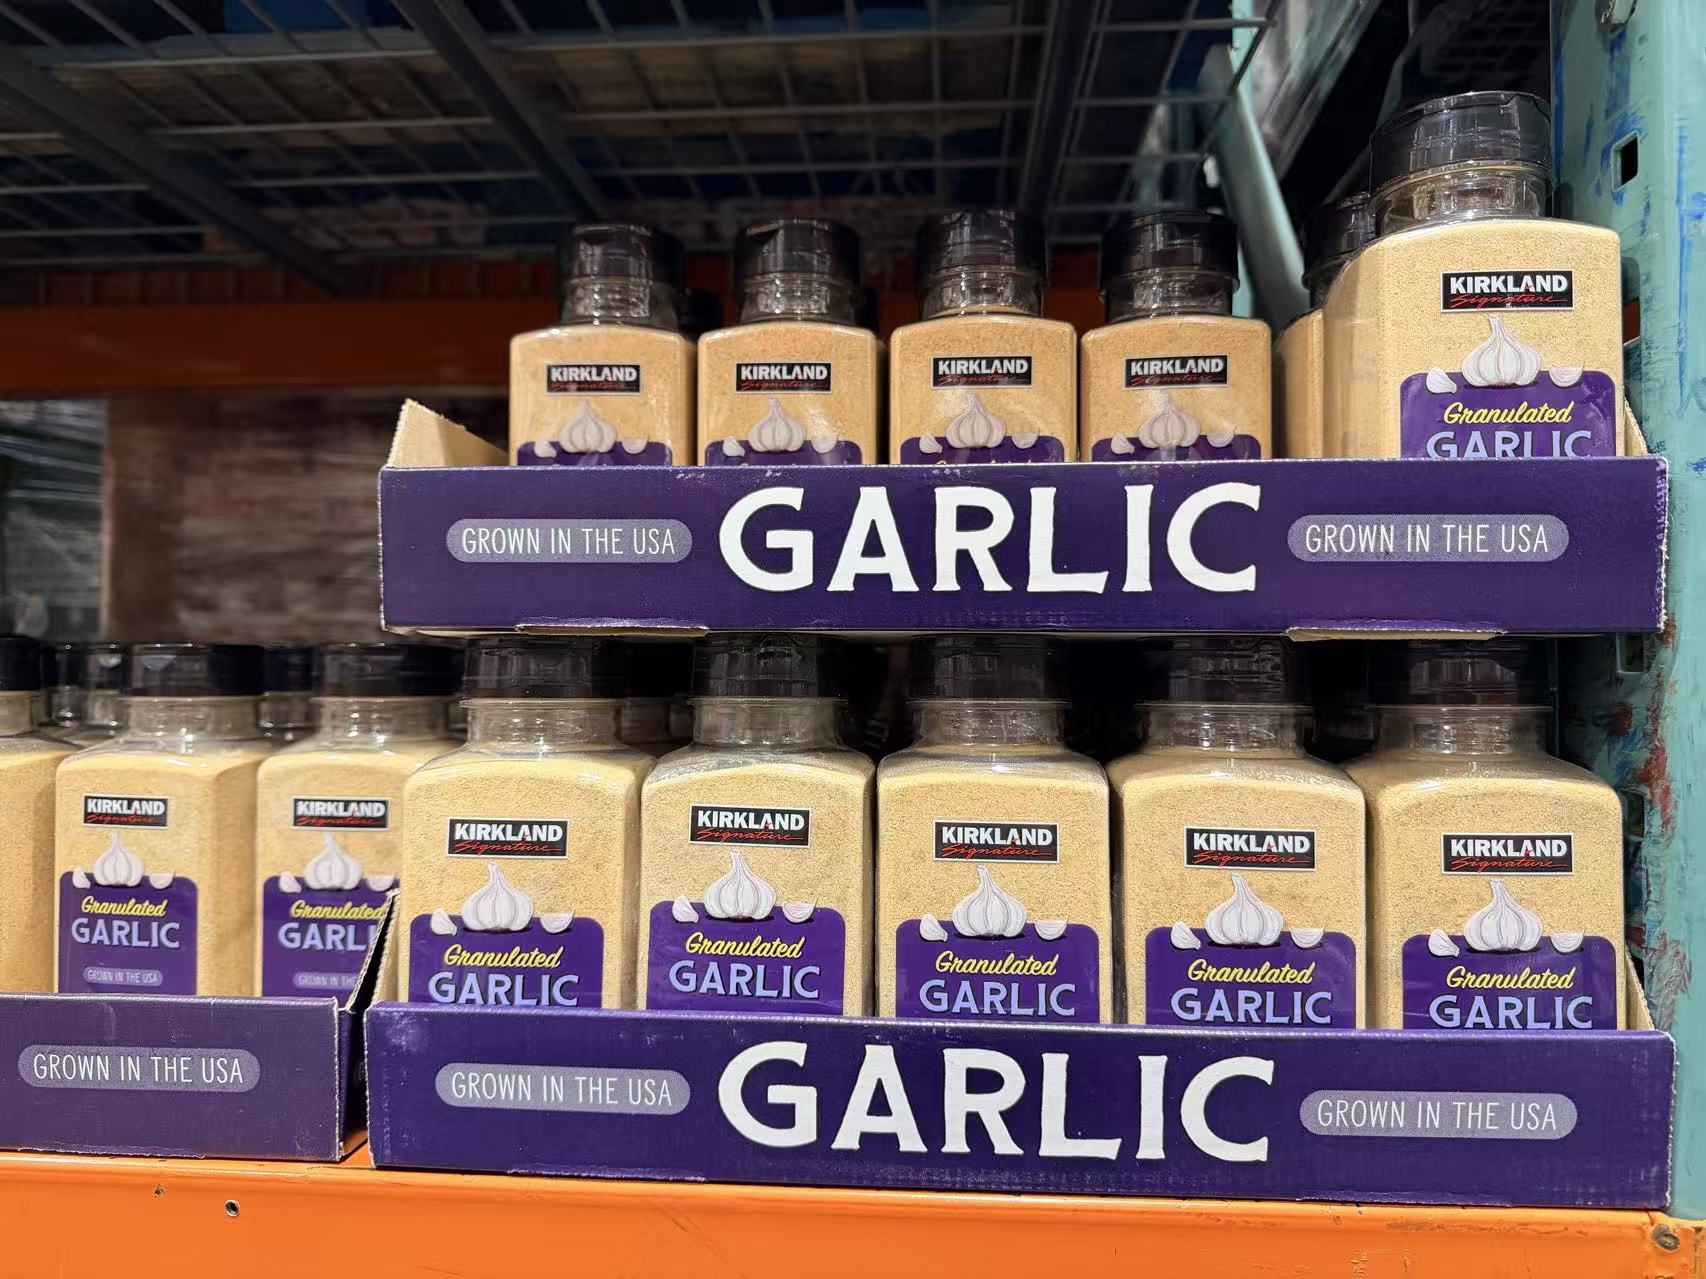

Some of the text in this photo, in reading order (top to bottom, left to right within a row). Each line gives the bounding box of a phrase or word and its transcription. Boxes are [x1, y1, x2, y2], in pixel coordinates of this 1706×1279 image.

[1450, 274, 1569, 294] KIRKLAND
[1450, 292, 1568, 309] Signature
[551, 366, 638, 382] KIRKLAND
[740, 364, 828, 381] KIRKLAND
[937, 359, 1029, 375] KIRKLAND
[1130, 359, 1224, 376] KIRKLAND
[1443, 400, 1575, 424] Granulated
[1426, 430, 1592, 458] GARLIC
[461, 527, 676, 555] GROWN IN THE USA
[718, 481, 1261, 595] GARLIC
[1305, 524, 1549, 553] GROWN IN THE USA
[86, 798, 166, 816] KIRKLAND
[296, 800, 386, 818] KIRKLAND
[454, 822, 563, 842] KIRKLAND
[697, 809, 806, 831] KIRKLAND
[697, 826, 805, 844] Signature
[942, 825, 1053, 846] KIRKLAND
[1192, 832, 1311, 853] KIRKLAND
[454, 840, 562, 857] Signature
[941, 844, 1053, 861] Signature
[1191, 850, 1311, 868] Signature
[1450, 838, 1568, 857] KIRKLAND
[1451, 855, 1569, 874] Signature
[81, 895, 168, 917] Granulated
[71, 917, 181, 949] GARLIC
[278, 922, 377, 951] GARLI
[685, 931, 806, 959] Granulated
[444, 943, 565, 969] Granulated
[935, 950, 1060, 976] Granulated
[87, 969, 159, 984] GROWN IN THE USA
[668, 959, 821, 999] GARLIC
[1187, 958, 1317, 984] Granulated
[1446, 965, 1577, 989] Granulated
[428, 970, 580, 1006] GARLIC
[919, 978, 1077, 1016] GARLIC
[1170, 987, 1333, 1025] GARLIC
[1428, 994, 1594, 1029] GARLIC
[33, 1053, 243, 1084] GROWN IN THE USA
[451, 1071, 672, 1107] GROWN IN THE USA
[717, 1040, 1275, 1163] GARLIC
[1317, 1099, 1557, 1131] GROWN IN THE USA
